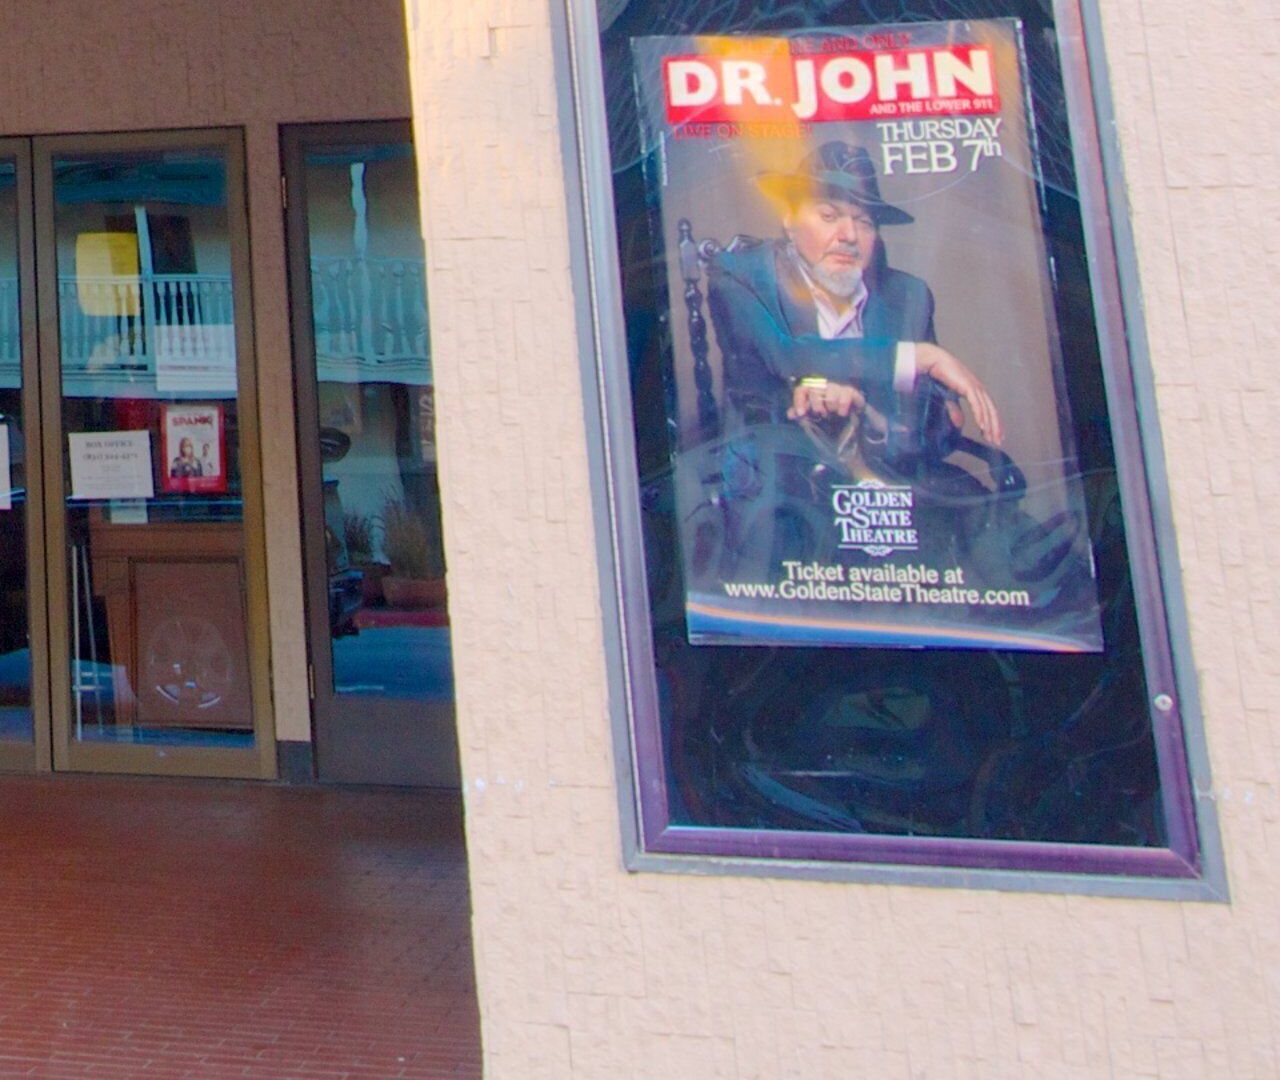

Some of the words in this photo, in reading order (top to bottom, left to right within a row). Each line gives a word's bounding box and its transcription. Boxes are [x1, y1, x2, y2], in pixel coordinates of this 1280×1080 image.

[862, 31, 912, 50] ONLY
[667, 59, 784, 108] DR.
[790, 49, 995, 119] JOHN
[869, 103, 897, 116] AND
[899, 101, 924, 114] THE
[925, 99, 971, 113] LOWER
[673, 123, 711, 140] LIVE
[717, 122, 744, 139] ON
[877, 117, 1002, 142] THURSDAY
[880, 141, 957, 176] FEB
[960, 137, 1002, 173] 7th
[832, 489, 913, 517] GOLDEN
[850, 505, 913, 528] STATE
[834, 516, 919, 544] THEATRE
[782, 560, 844, 582] Ticket
[848, 563, 939, 585] available
[943, 566, 965, 586] at
[724, 579, 1031, 607] www.GoldenStateTheatre.com
